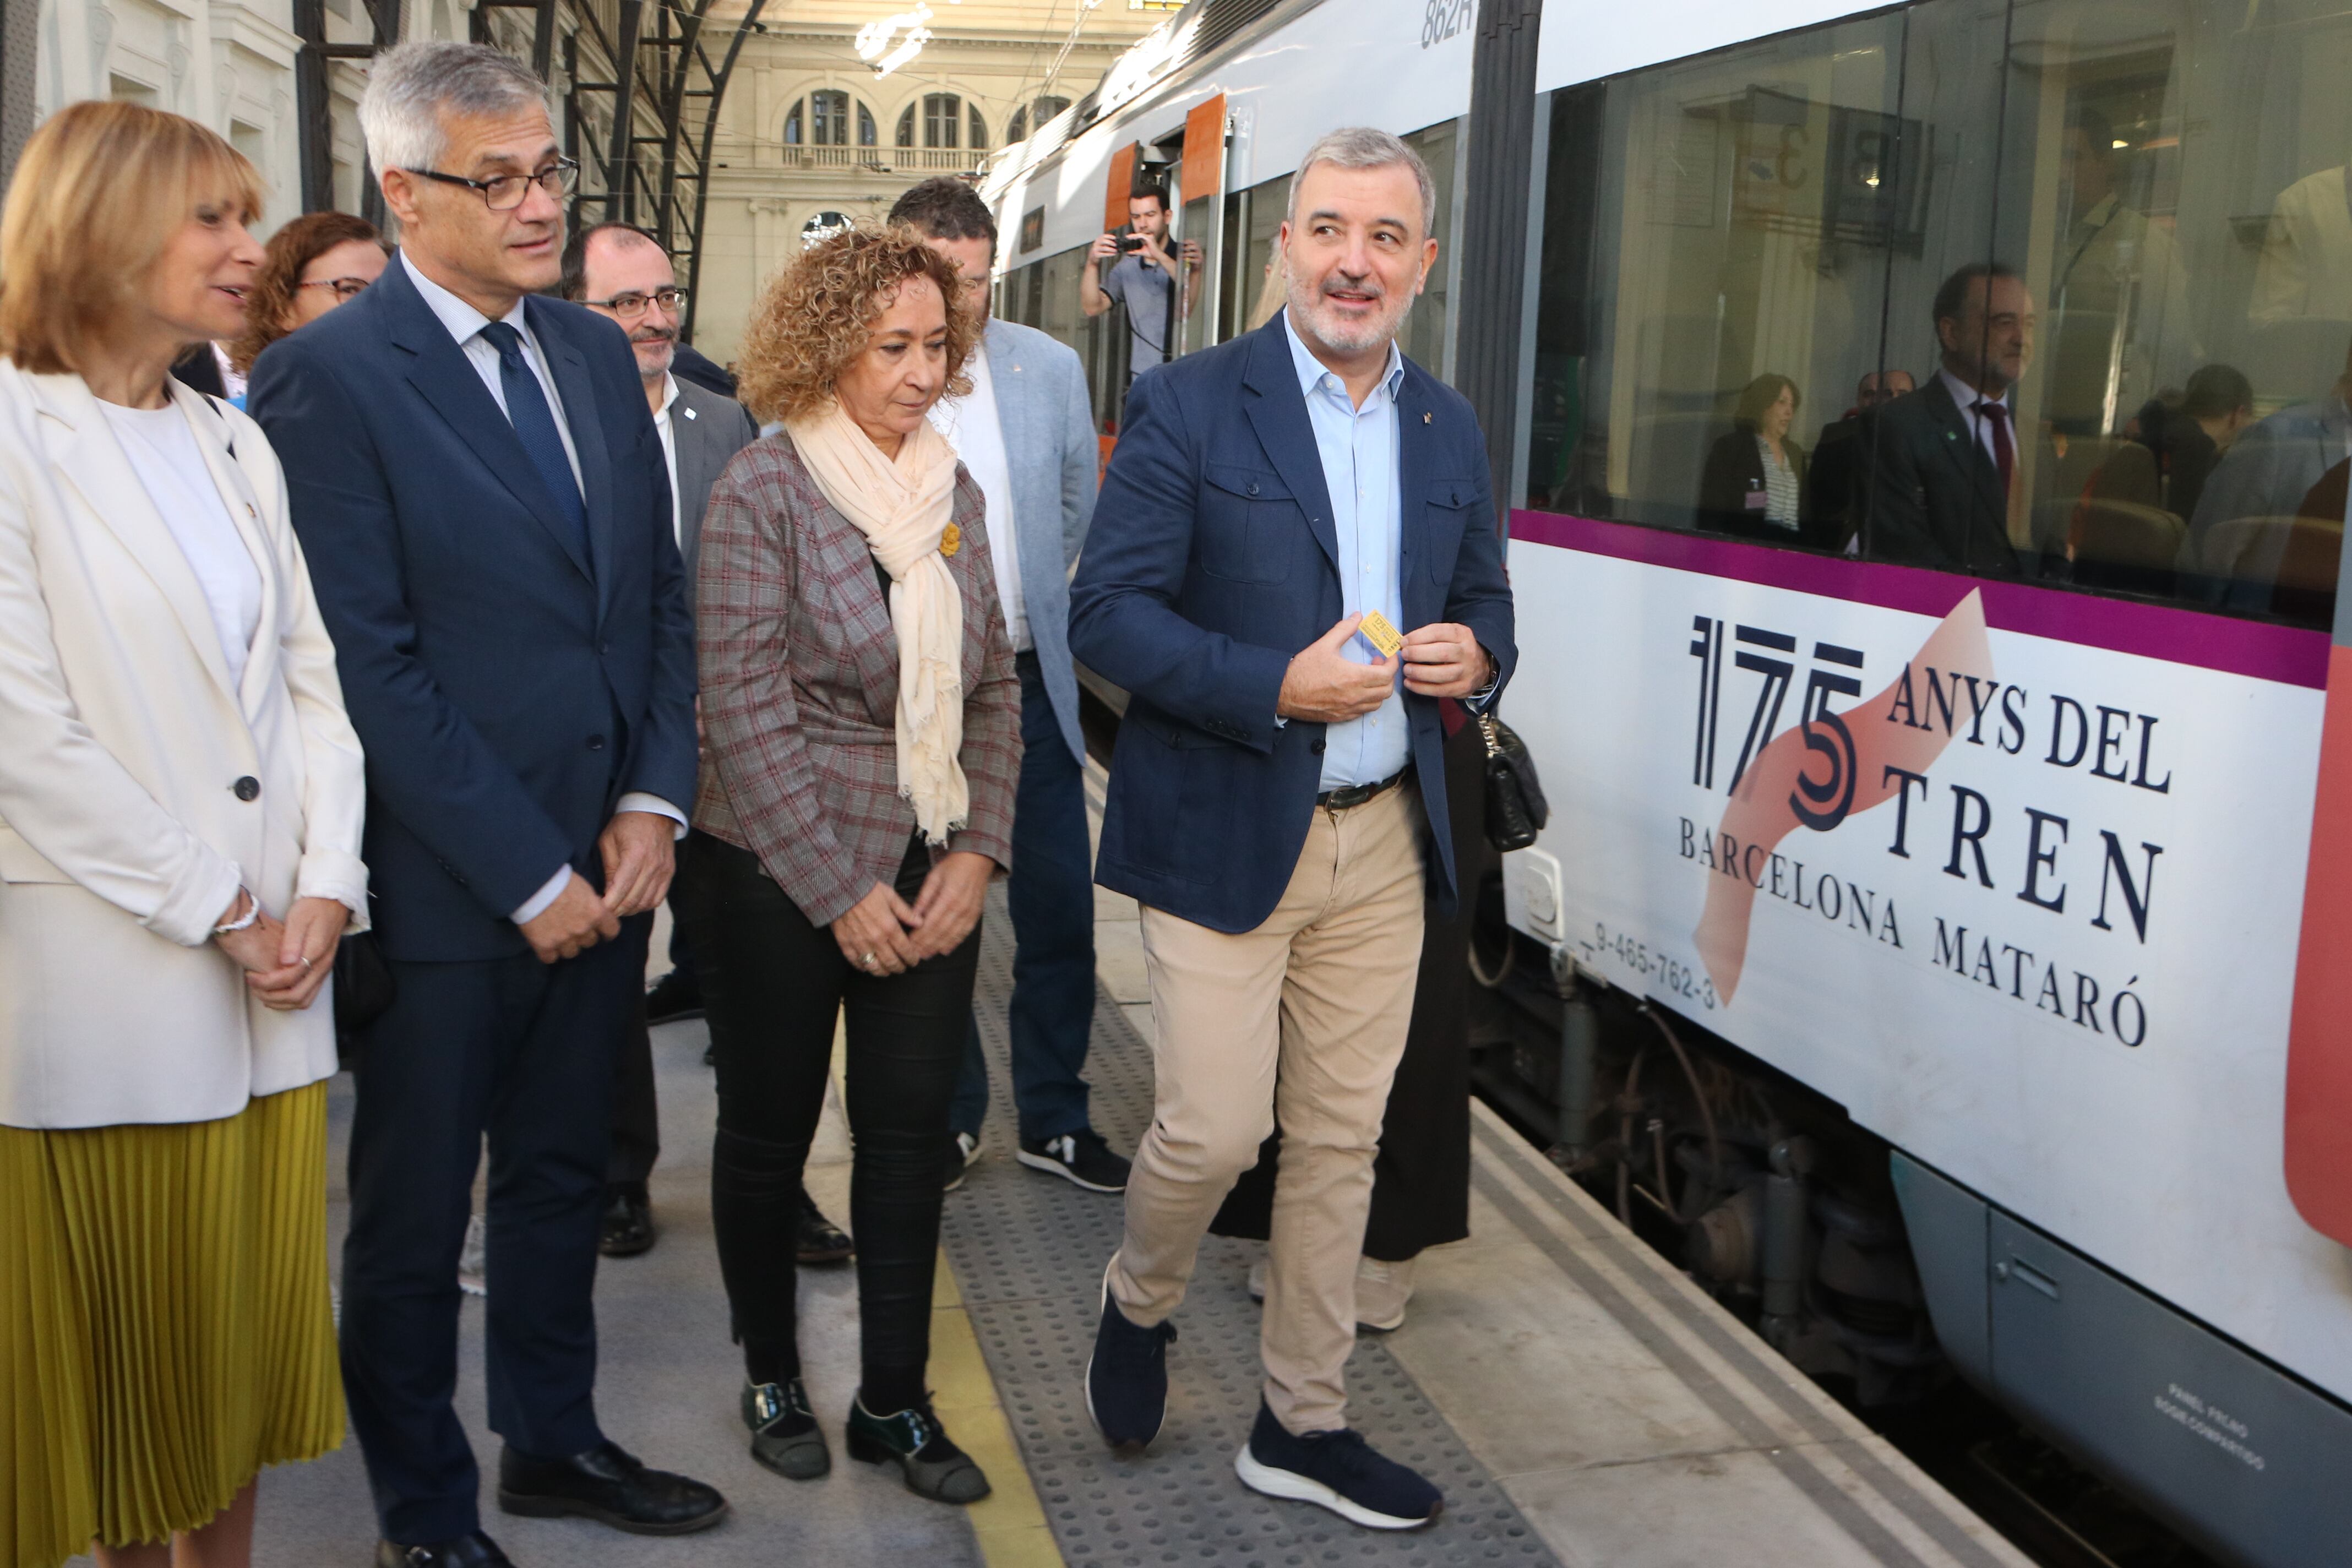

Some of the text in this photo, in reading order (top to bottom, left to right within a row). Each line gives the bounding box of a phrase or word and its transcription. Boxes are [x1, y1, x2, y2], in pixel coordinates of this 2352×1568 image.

[1689, 614, 2171, 832] 175 ANYS DEL
[1679, 816, 2147, 1048] BARCELONA MATARÓ
[1882, 764, 2163, 945] TREN
